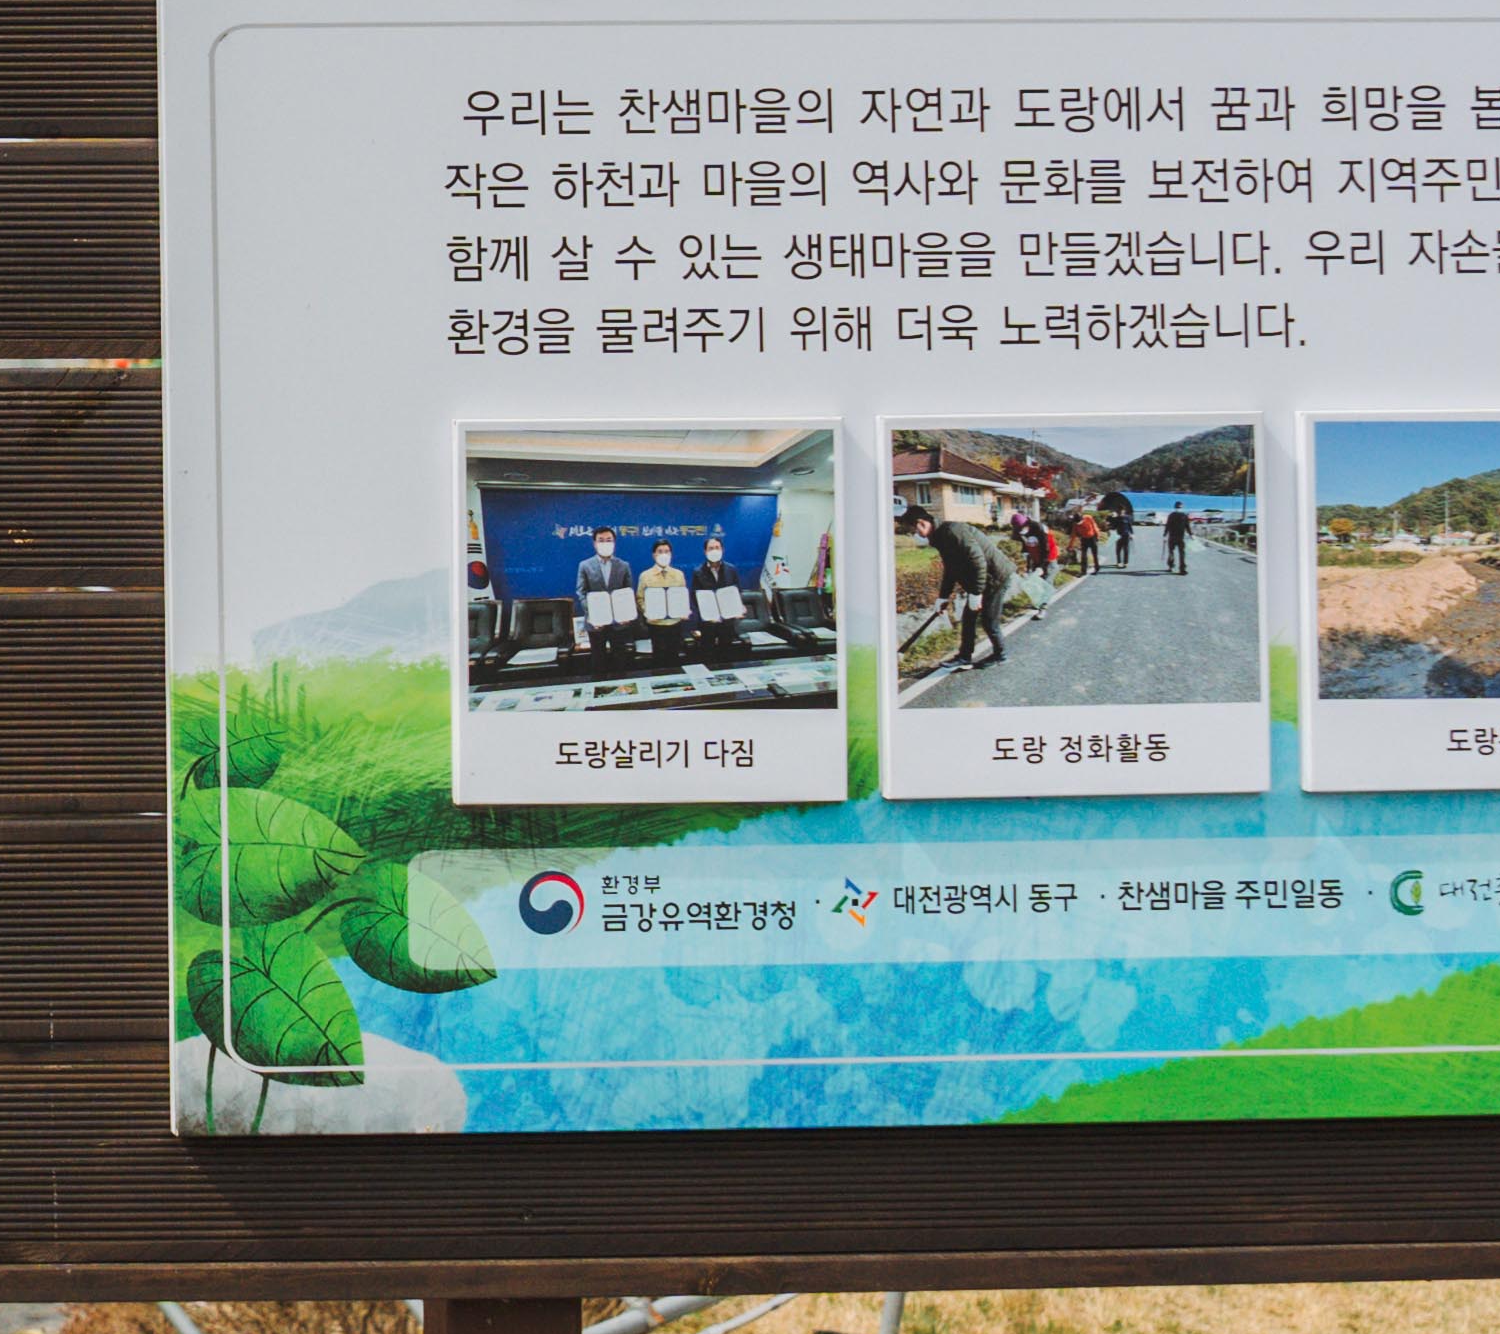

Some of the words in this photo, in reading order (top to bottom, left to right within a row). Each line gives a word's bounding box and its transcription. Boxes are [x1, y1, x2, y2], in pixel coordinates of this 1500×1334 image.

[463, 89, 594, 137] 우리는
[618, 87, 833, 135] 찬샘마을의
[859, 86, 991, 134] 자연과
[1014, 86, 1184, 133] 도랑에서
[1210, 85, 1296, 132] 꿈과
[1321, 84, 1447, 132] 희망을
[444, 162, 529, 210] 작은
[551, 161, 680, 209] 하천과
[703, 160, 827, 208] 마을의
[852, 159, 979, 207] 역사와
[999, 158, 1126, 205] 문화를
[1148, 157, 1313, 204] 보전하여
[446, 235, 529, 282] 함께
[551, 234, 594, 281] 살
[614, 235, 657, 281] 수
[679, 233, 762, 280] 있는
[783, 231, 996, 281] 생태마을을
[1019, 230, 1281, 277] 만들겠습니다.
[1304, 229, 1384, 276] 우리
[447, 308, 575, 356] 환경을
[596, 306, 764, 354] 물려주기
[790, 305, 872, 352] 위해
[897, 304, 979, 351] 더욱
[999, 302, 1305, 350] 노력하겠습니다.
[555, 739, 689, 770] 도랑살리기
[704, 738, 754, 768] 다짐
[992, 735, 1048, 765] 도랑
[1059, 733, 1171, 764] 정화활동
[600, 873, 662, 896] 환경부
[893, 883, 1017, 915] 대전광역시
[1028, 883, 1078, 914] 동구
[1117, 880, 1227, 911] 찬샘마을
[1234, 878, 1345, 910] 주민일동
[601, 900, 796, 933] 금강유역환경청
